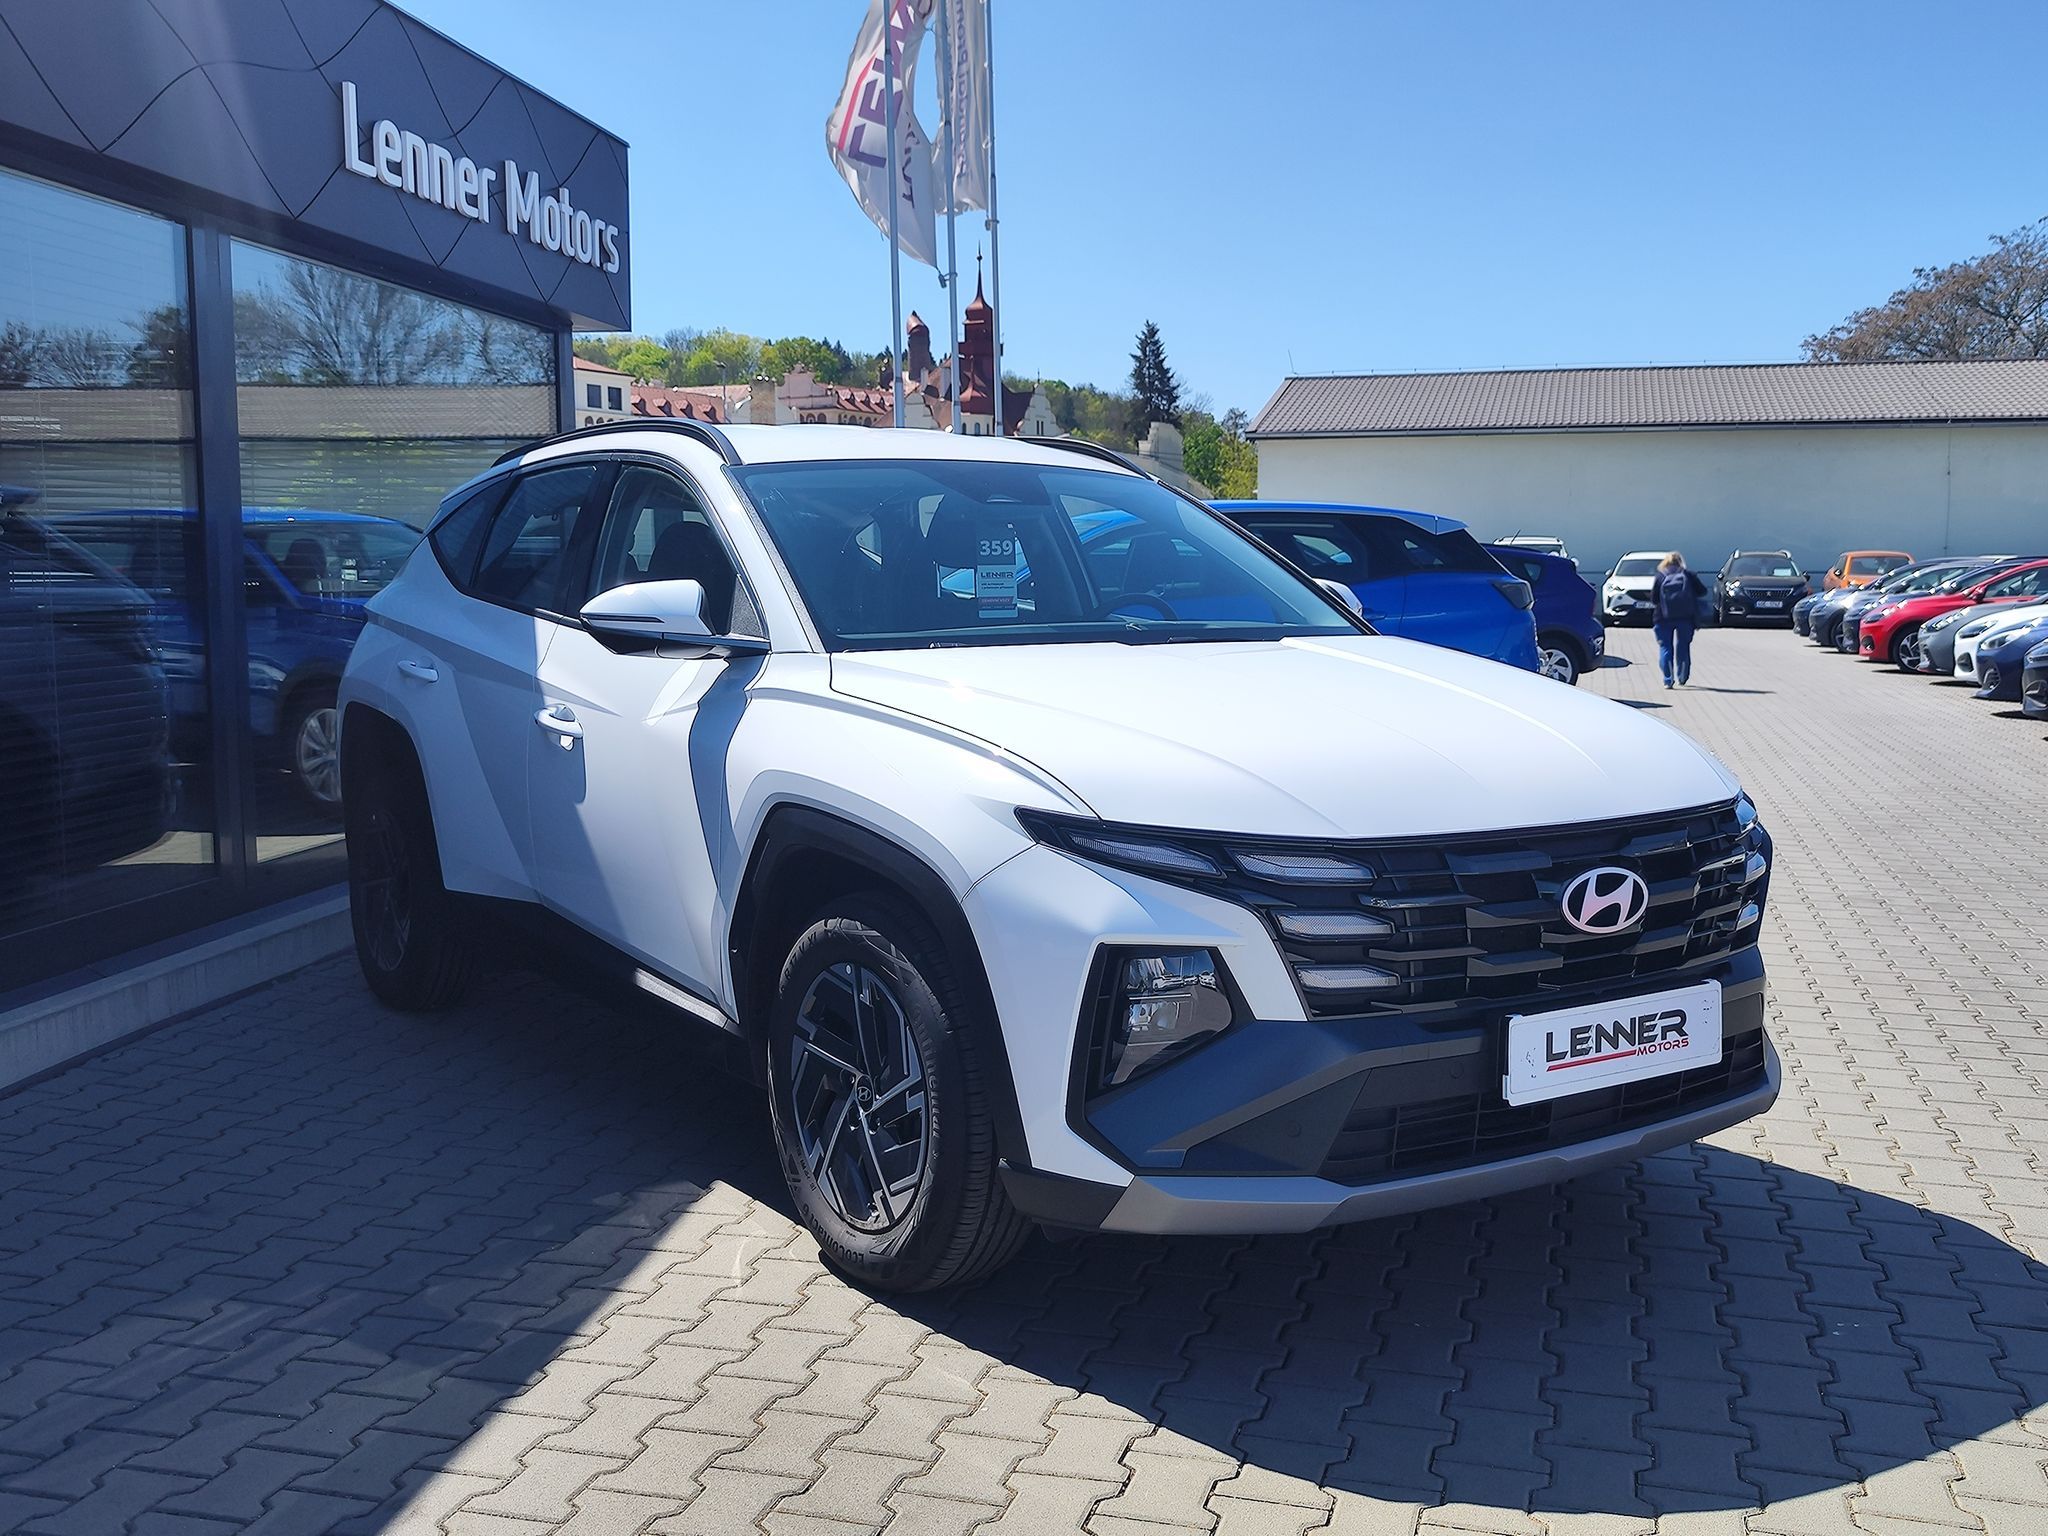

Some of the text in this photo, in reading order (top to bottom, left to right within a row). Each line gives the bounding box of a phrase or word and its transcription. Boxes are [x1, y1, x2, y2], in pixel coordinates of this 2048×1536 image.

[341, 80, 620, 274] Lenner Motors
[979, 540, 1013, 556] 359
[1546, 1009, 1689, 1063] LENNER
[1637, 1037, 1690, 1057] MOTORS
